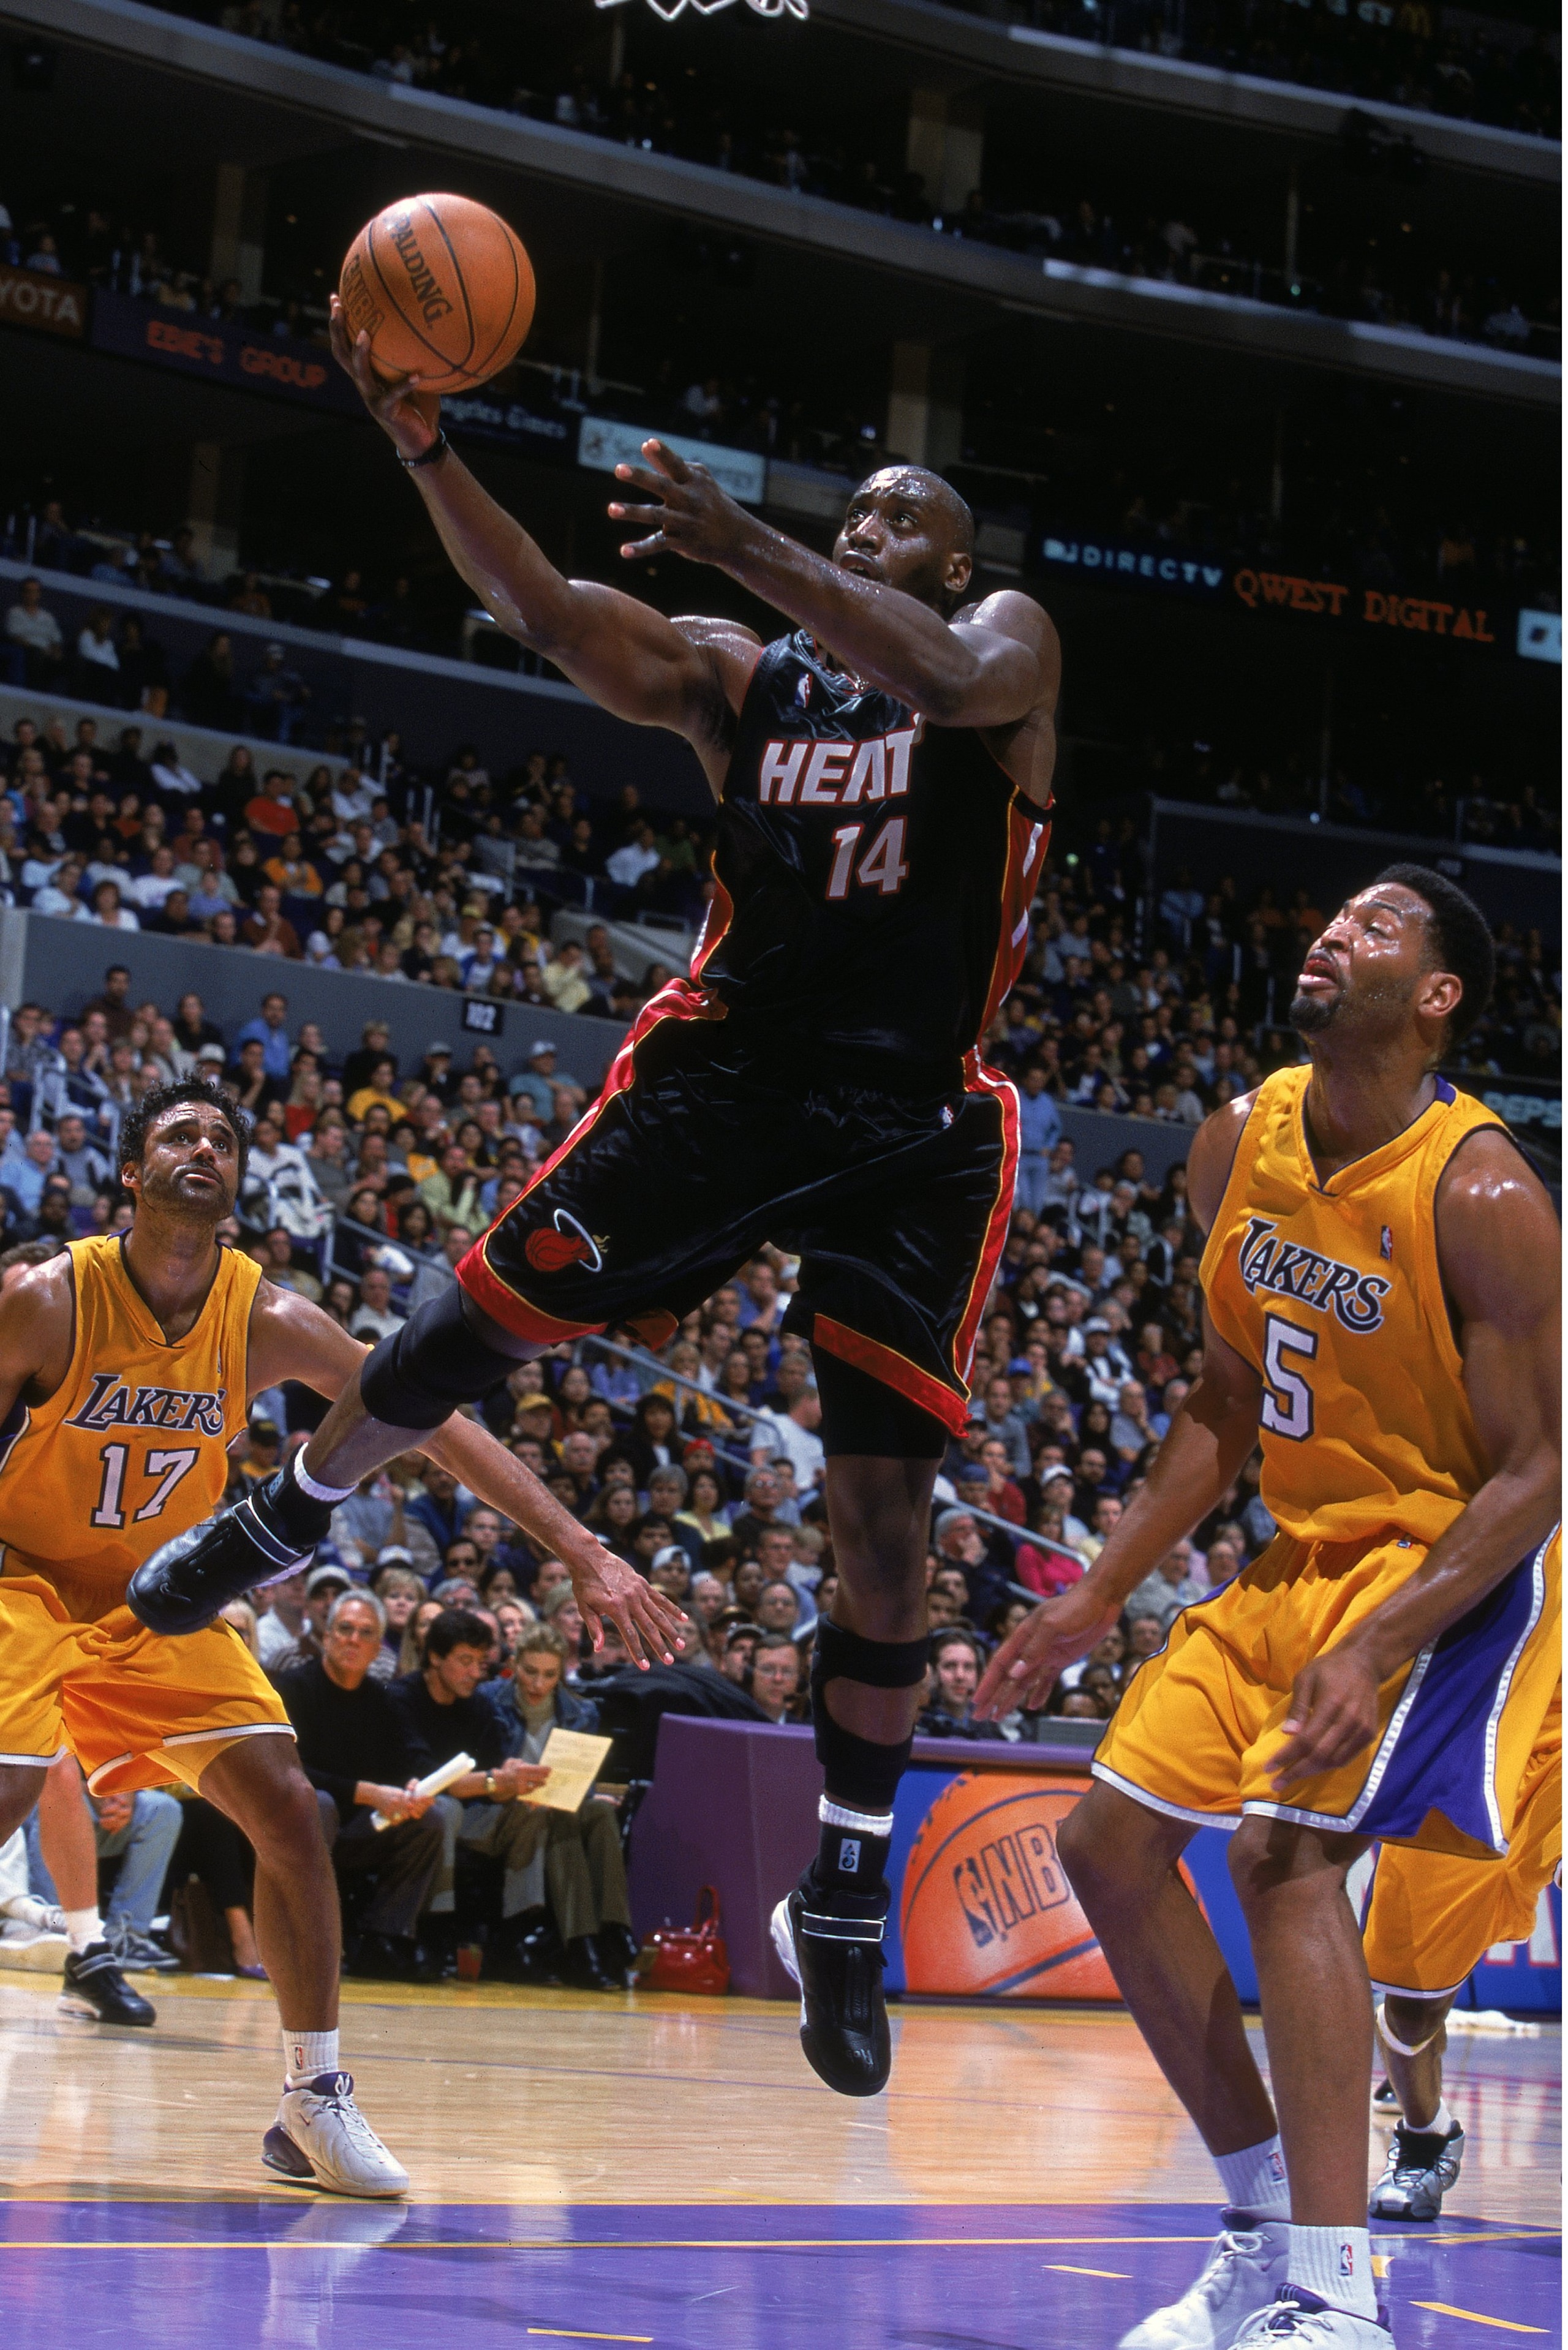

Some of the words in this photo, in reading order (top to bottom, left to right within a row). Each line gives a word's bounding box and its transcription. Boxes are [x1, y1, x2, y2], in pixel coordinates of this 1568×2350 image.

[385, 213, 454, 326] PALDING
[239, 347, 328, 390] GROUP
[1082, 544, 1223, 587] DIRECTV
[1233, 568, 1349, 617] QWEST
[1363, 590, 1495, 643] DIGITAL
[758, 712, 925, 805] HEAT
[825, 815, 910, 900] 14
[1239, 1215, 1392, 1334] LAKERS
[1259, 1311, 1319, 1442] 5
[90, 1441, 200, 1530] 17
[981, 1820, 1072, 1929] NB
